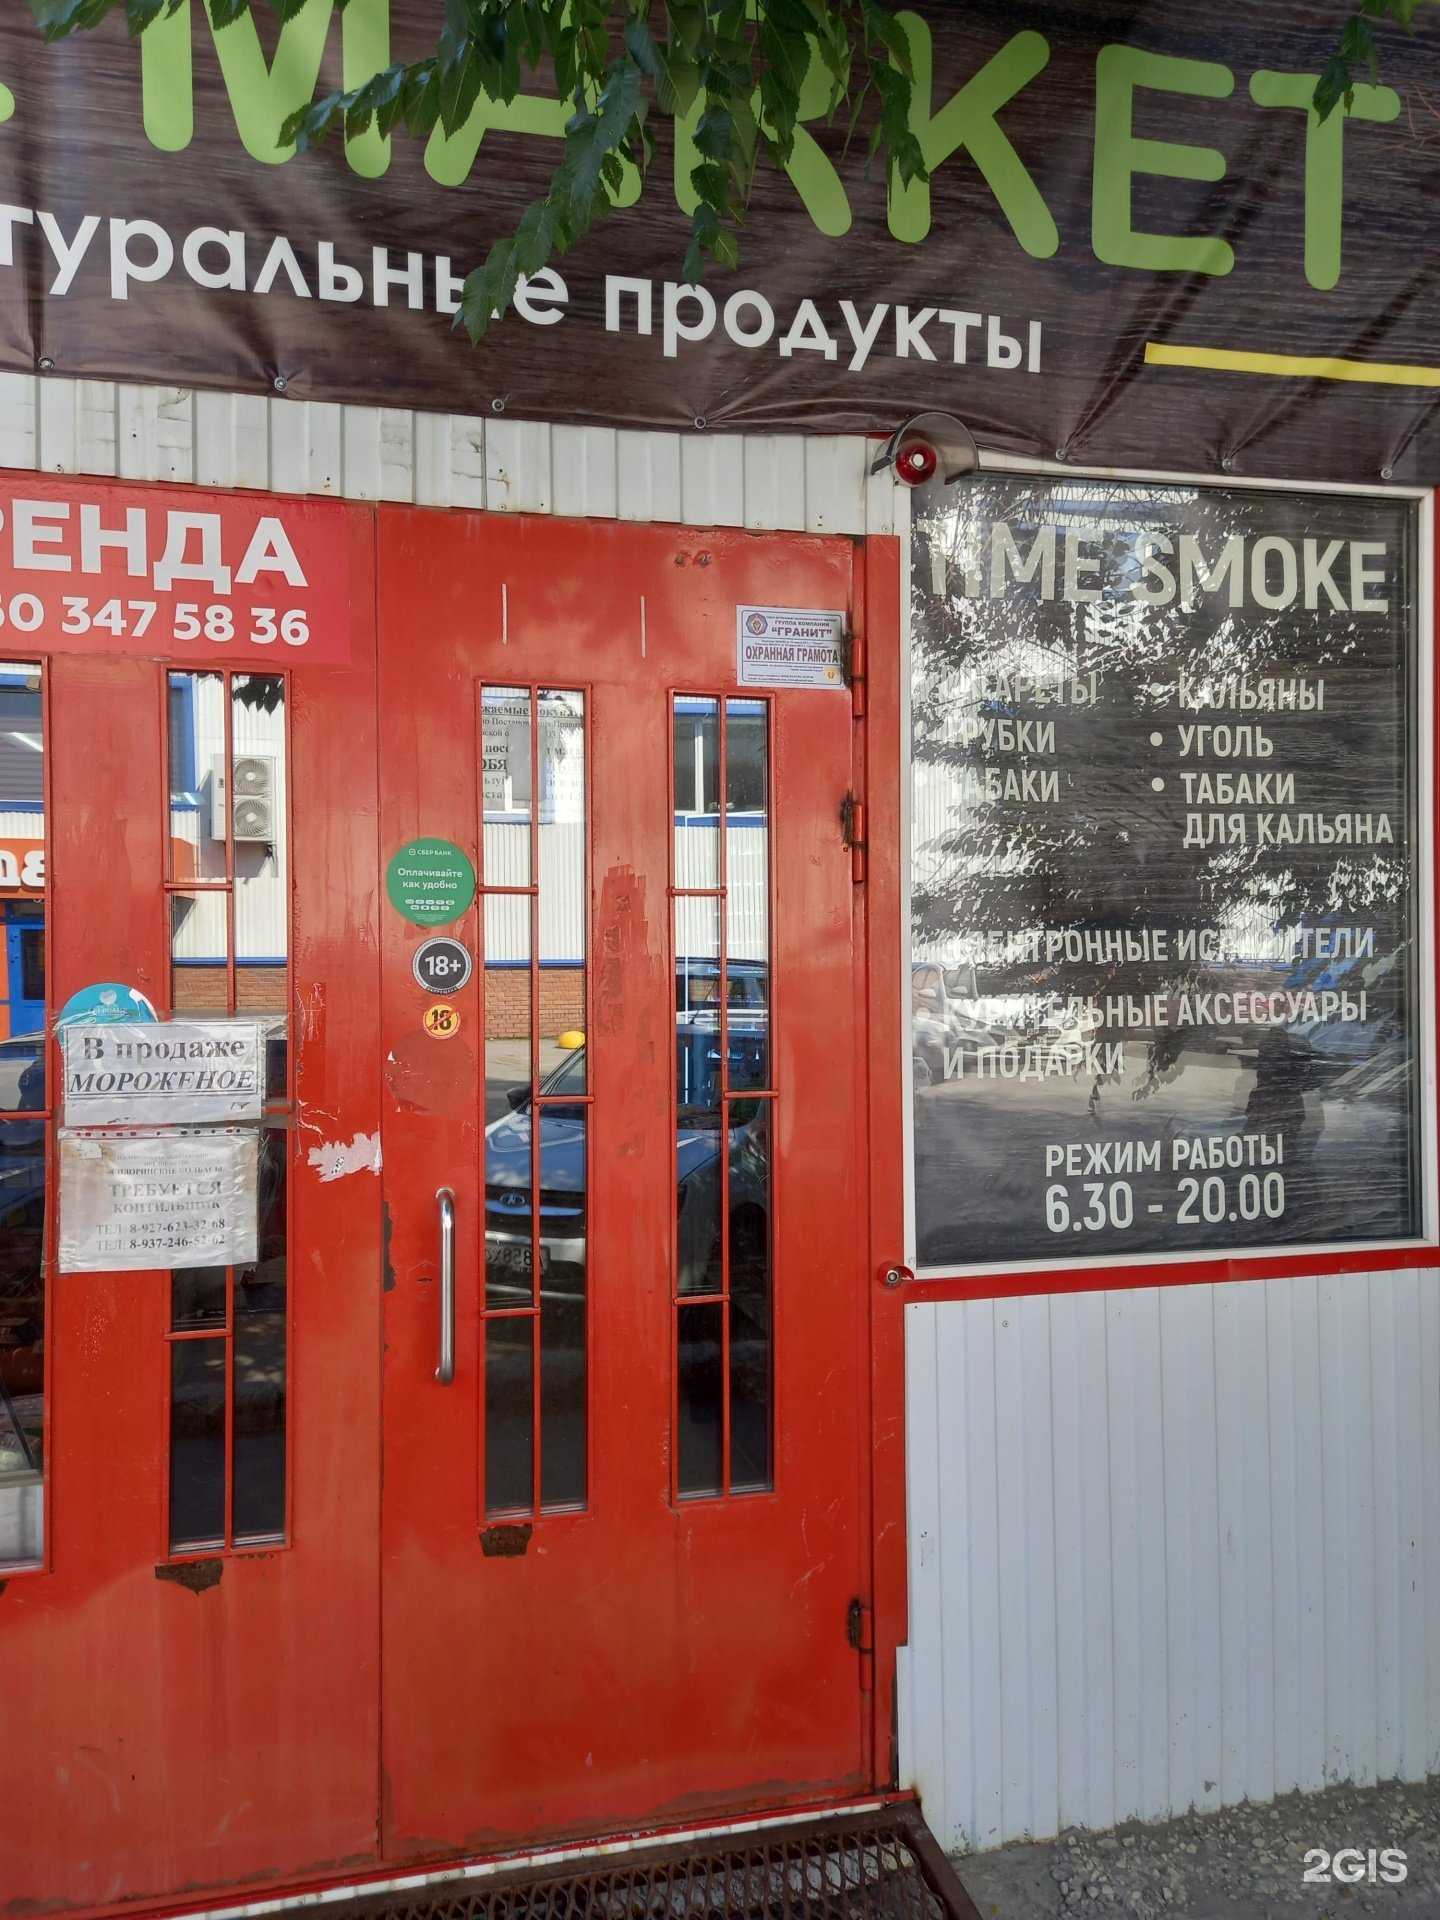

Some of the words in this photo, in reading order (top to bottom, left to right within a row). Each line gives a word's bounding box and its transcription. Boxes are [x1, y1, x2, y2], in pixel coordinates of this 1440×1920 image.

[606, 274, 1041, 373] продукты
[0, 498, 309, 595] ЕНДА
[1132, 532, 1388, 612] SMOKE
[0, 593, 45, 632] 0
[62, 597, 157, 637] 347
[173, 603, 235, 642] 58
[250, 607, 310, 646] 36
[745, 646, 795, 661] ОХРАННАЯ
[797, 647, 839, 664] ГРАМОТА
[1178, 676, 1325, 710] КАЛЬЯНЫ
[1178, 725, 1273, 757] УГОЛЬ
[1180, 773, 1295, 804] ТАБАКИ
[1183, 813, 1246, 848] ДЛЯ
[1257, 814, 1394, 844] КАЛЬЯНА
[397, 867, 463, 878] Оплачивайте
[423, 880, 458, 890] удобно
[424, 955, 461, 976] 18+
[1177, 991, 1367, 1026] АКСЕССУАРЫ
[84, 1037, 104, 1060] В
[116, 1040, 246, 1064] продаже
[944, 1047, 964, 1080] И
[977, 1042, 1125, 1083] ПОДАРКИ
[70, 1070, 255, 1093] МОРОЖЕНОЕ
[1046, 1140, 1160, 1177] РЕЖИМ
[1172, 1134, 1283, 1171] РАБОТЫ
[1046, 1181, 1133, 1232] 6.30
[1177, 1172, 1285, 1224] 20.00
